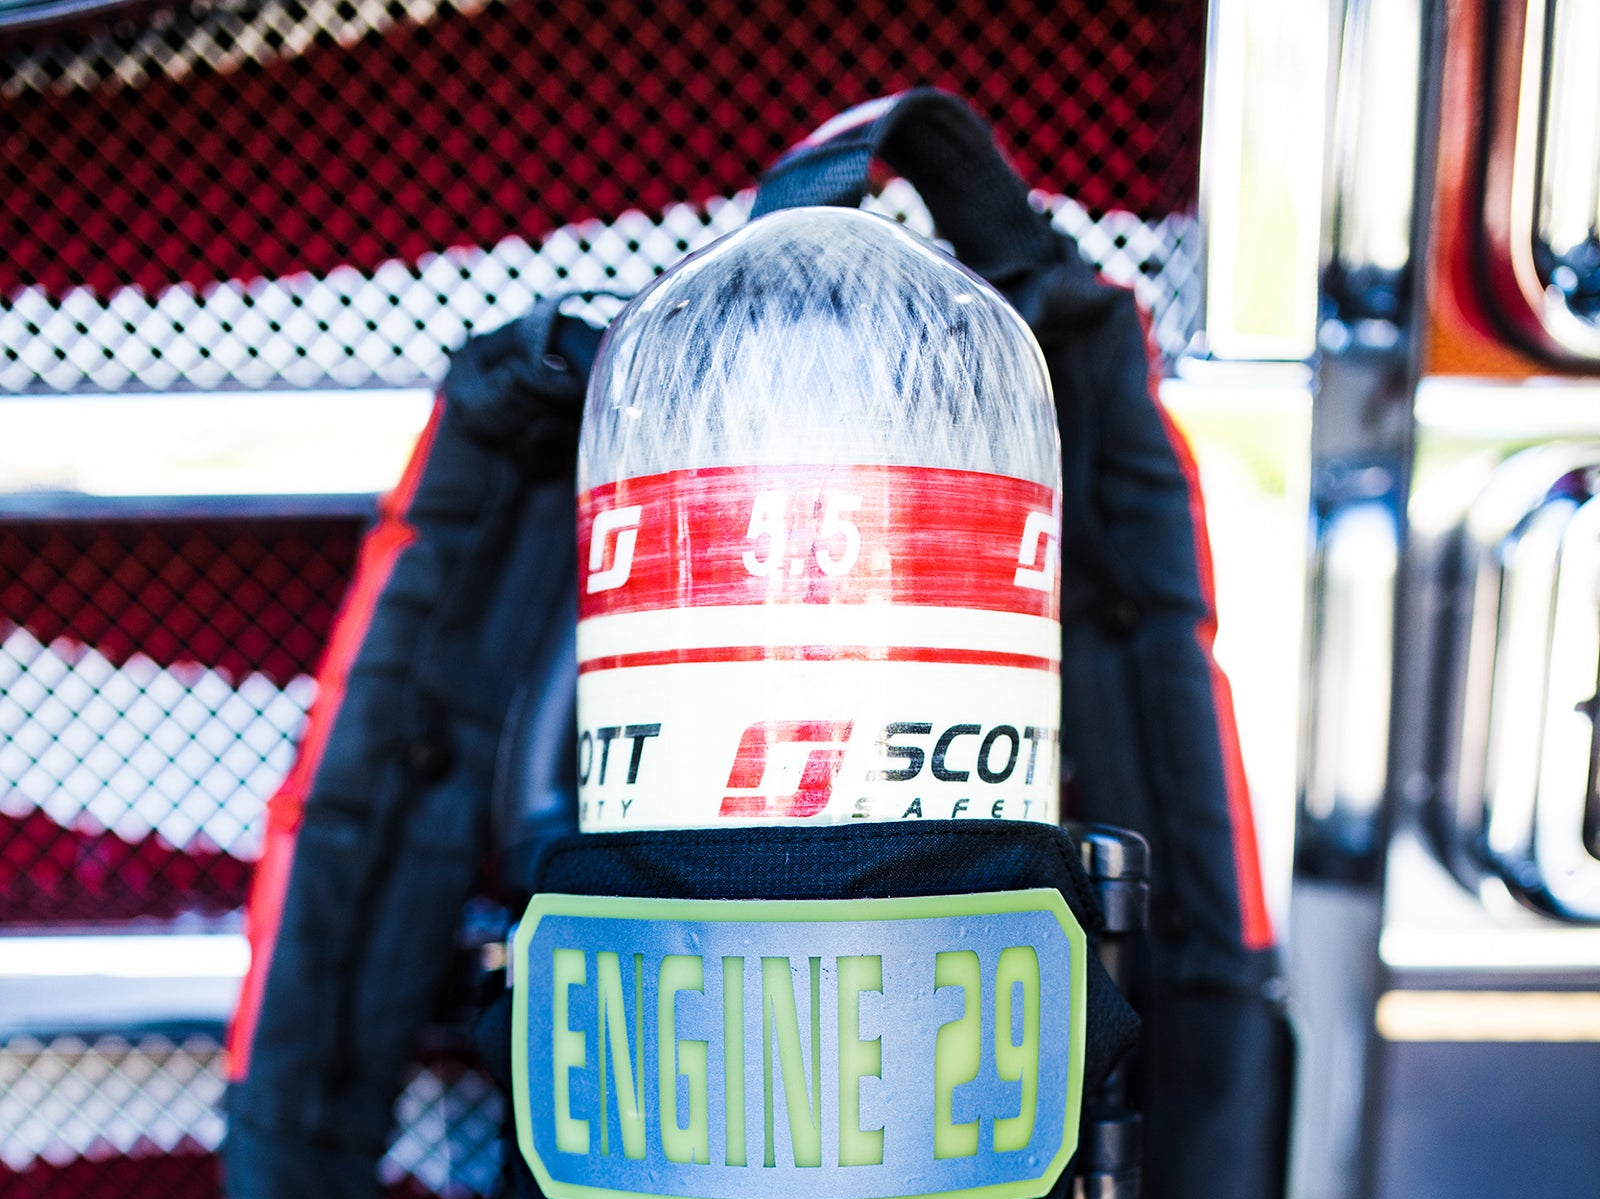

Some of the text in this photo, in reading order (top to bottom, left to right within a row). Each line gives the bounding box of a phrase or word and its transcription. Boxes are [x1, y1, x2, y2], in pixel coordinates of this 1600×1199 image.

[743, 496, 862, 577] 5.5
[578, 723, 661, 786] OTT
[866, 722, 1058, 785] SCOT
[553, 946, 1040, 1168] ENGINE 29
